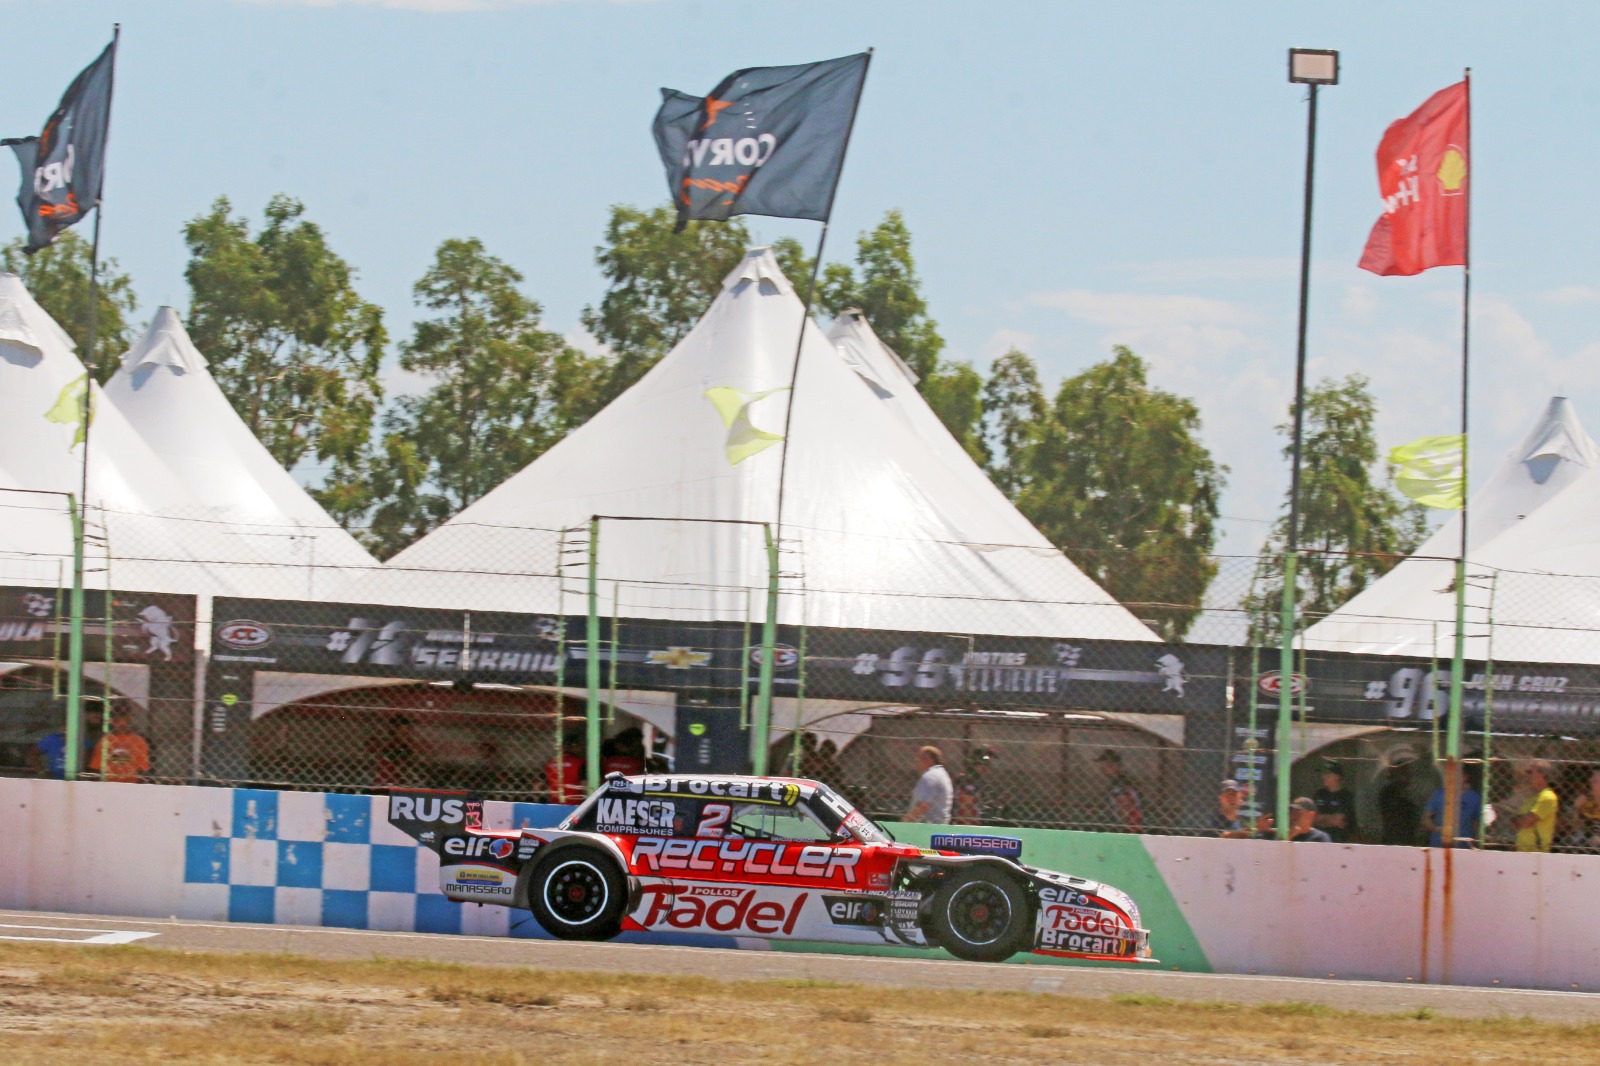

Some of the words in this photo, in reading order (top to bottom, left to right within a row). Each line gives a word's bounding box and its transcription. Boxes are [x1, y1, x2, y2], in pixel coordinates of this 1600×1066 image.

[1364, 667, 1452, 720] #96
[644, 778, 784, 801] Brocart
[390, 796, 464, 824] RUS
[596, 798, 676, 828] KAESER
[696, 803, 732, 838] 2
[596, 824, 674, 836] COMPRESORES
[444, 837, 491, 856] elf
[934, 836, 1019, 850] MANASSERO
[446, 883, 512, 895] MANASSERO
[694, 887, 739, 897] POLLOS
[1038, 887, 1078, 904] elf
[641, 883, 809, 936] Fadel
[830, 901, 863, 920] elf
[1045, 904, 1120, 936] Fadel
[1041, 929, 1120, 954] Brocart
